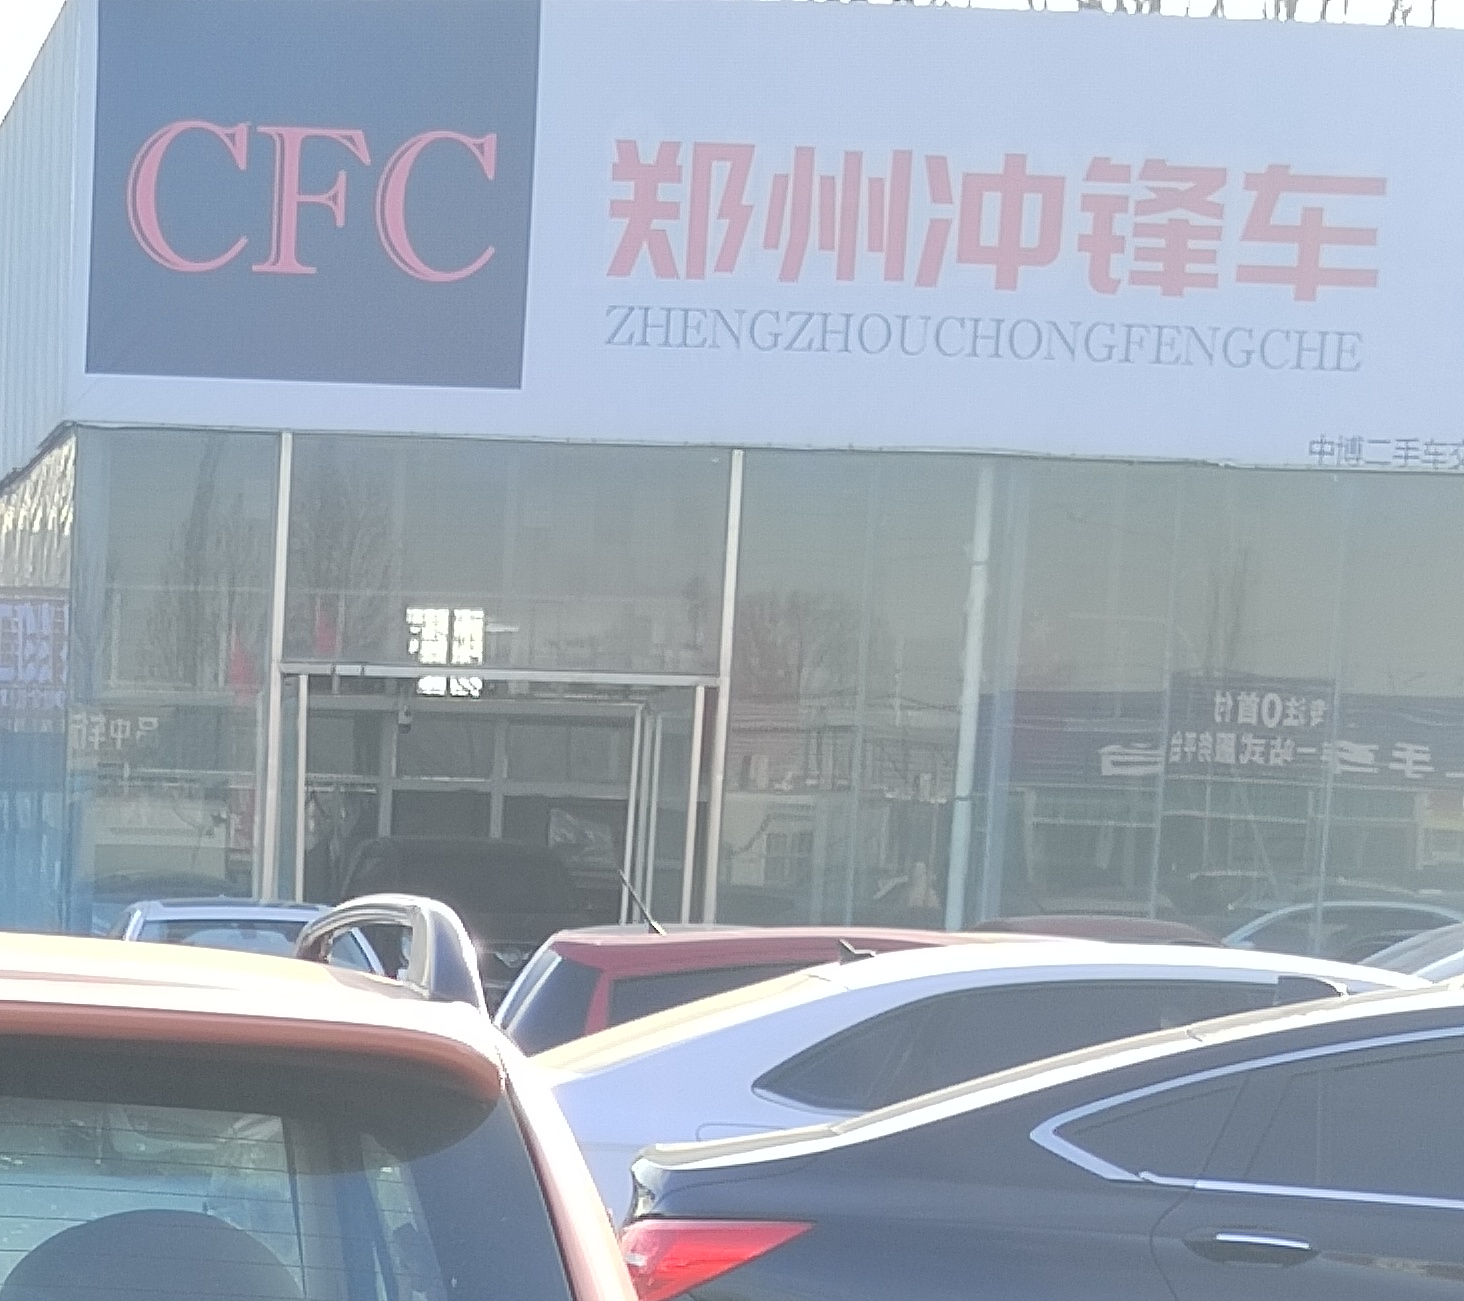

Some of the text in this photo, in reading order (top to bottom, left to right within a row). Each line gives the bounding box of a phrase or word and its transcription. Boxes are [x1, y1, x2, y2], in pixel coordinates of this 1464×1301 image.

[125, 119, 498, 284] CFC
[605, 138, 1388, 303] 郑州冲锋车
[603, 304, 1365, 374] ZHENGZHOUCHONGFENGCHE
